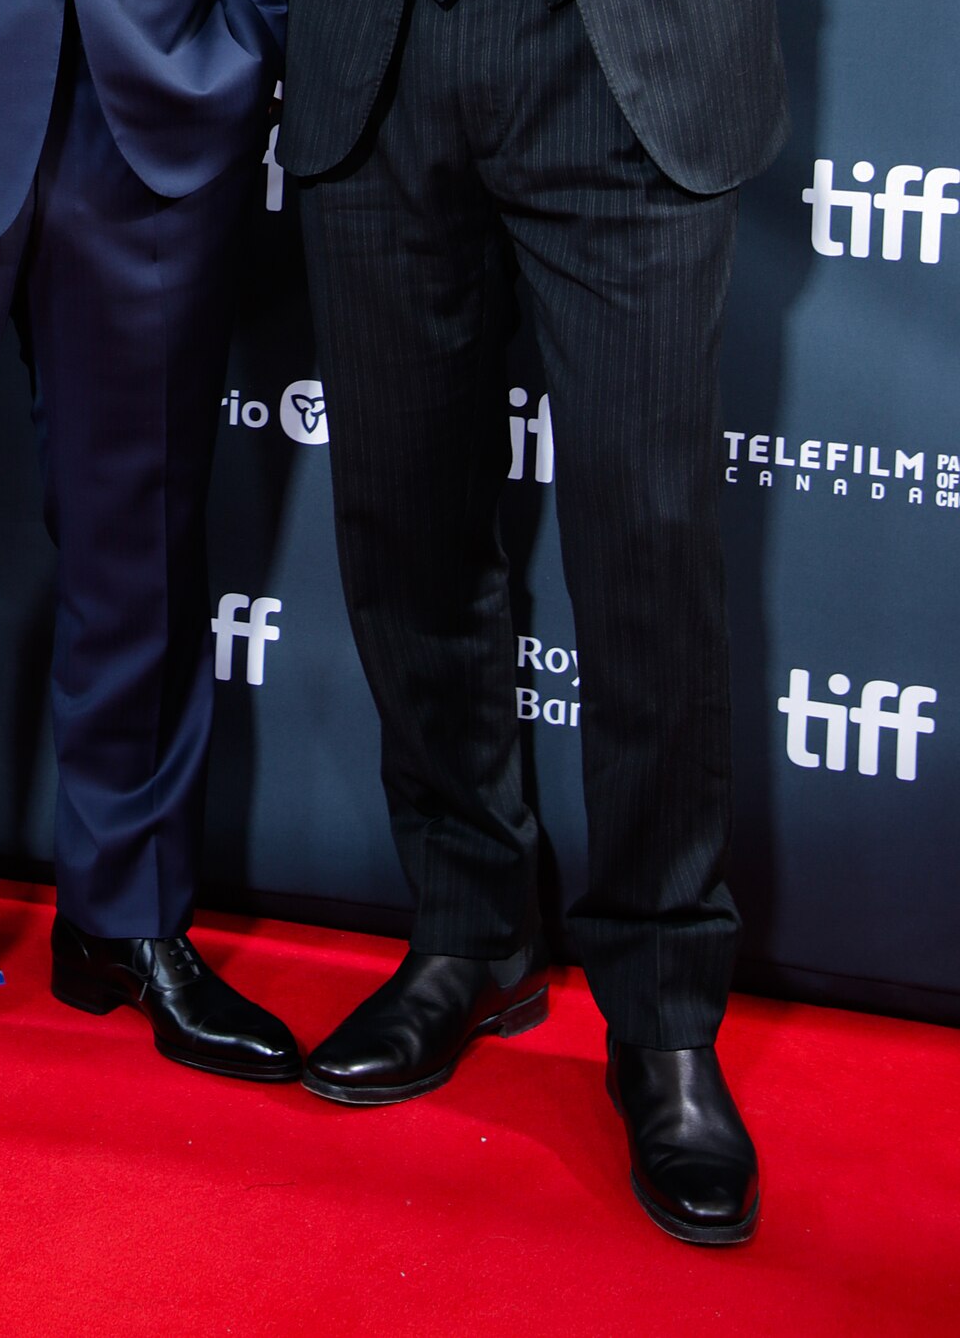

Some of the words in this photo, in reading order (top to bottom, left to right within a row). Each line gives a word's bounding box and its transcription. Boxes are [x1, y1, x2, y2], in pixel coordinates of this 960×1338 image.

[802, 158, 960, 264] tiff
[723, 430, 925, 481] TELEFILM
[936, 472, 960, 490] OF
[725, 466, 924, 505] CANADA
[777, 668, 938, 781] tiff
